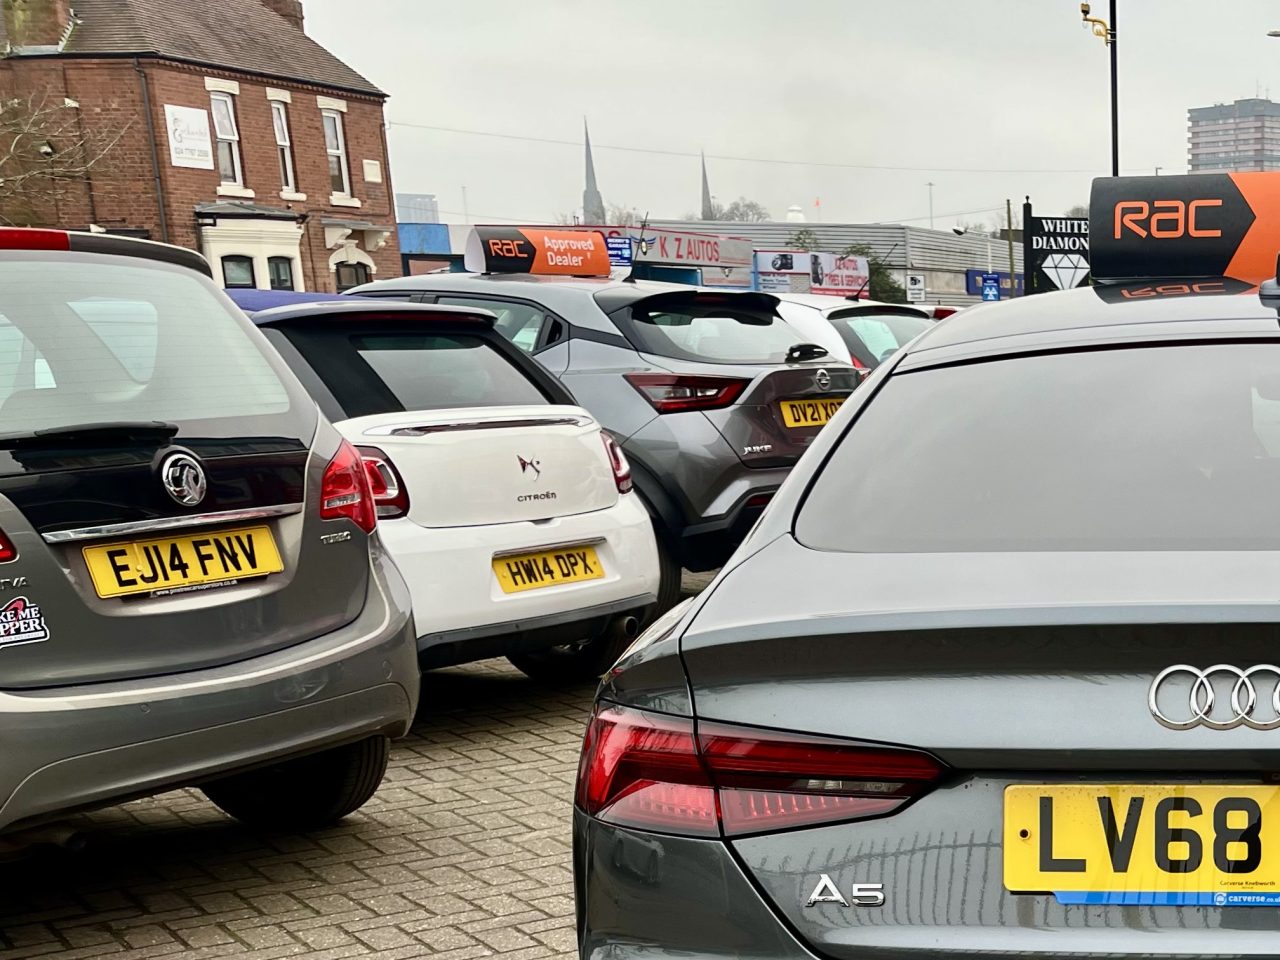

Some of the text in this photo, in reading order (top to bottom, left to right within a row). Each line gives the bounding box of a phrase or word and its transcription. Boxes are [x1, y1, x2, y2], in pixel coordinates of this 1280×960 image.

[1041, 219, 1089, 234] WHITE
[543, 236, 594, 251] Approved
[659, 236, 720, 262] K Z AUTOS
[547, 252, 584, 267] Dealer
[790, 401, 823, 423] DV21
[743, 444, 772, 455] JUKE
[320, 531, 351, 544] TURBO
[106, 533, 258, 588] EJ14 FNV
[506, 551, 595, 586] HW14 DPX
[18, 606, 40, 620] ME
[1038, 796, 1262, 874] LV68
[805, 873, 885, 907] A5
